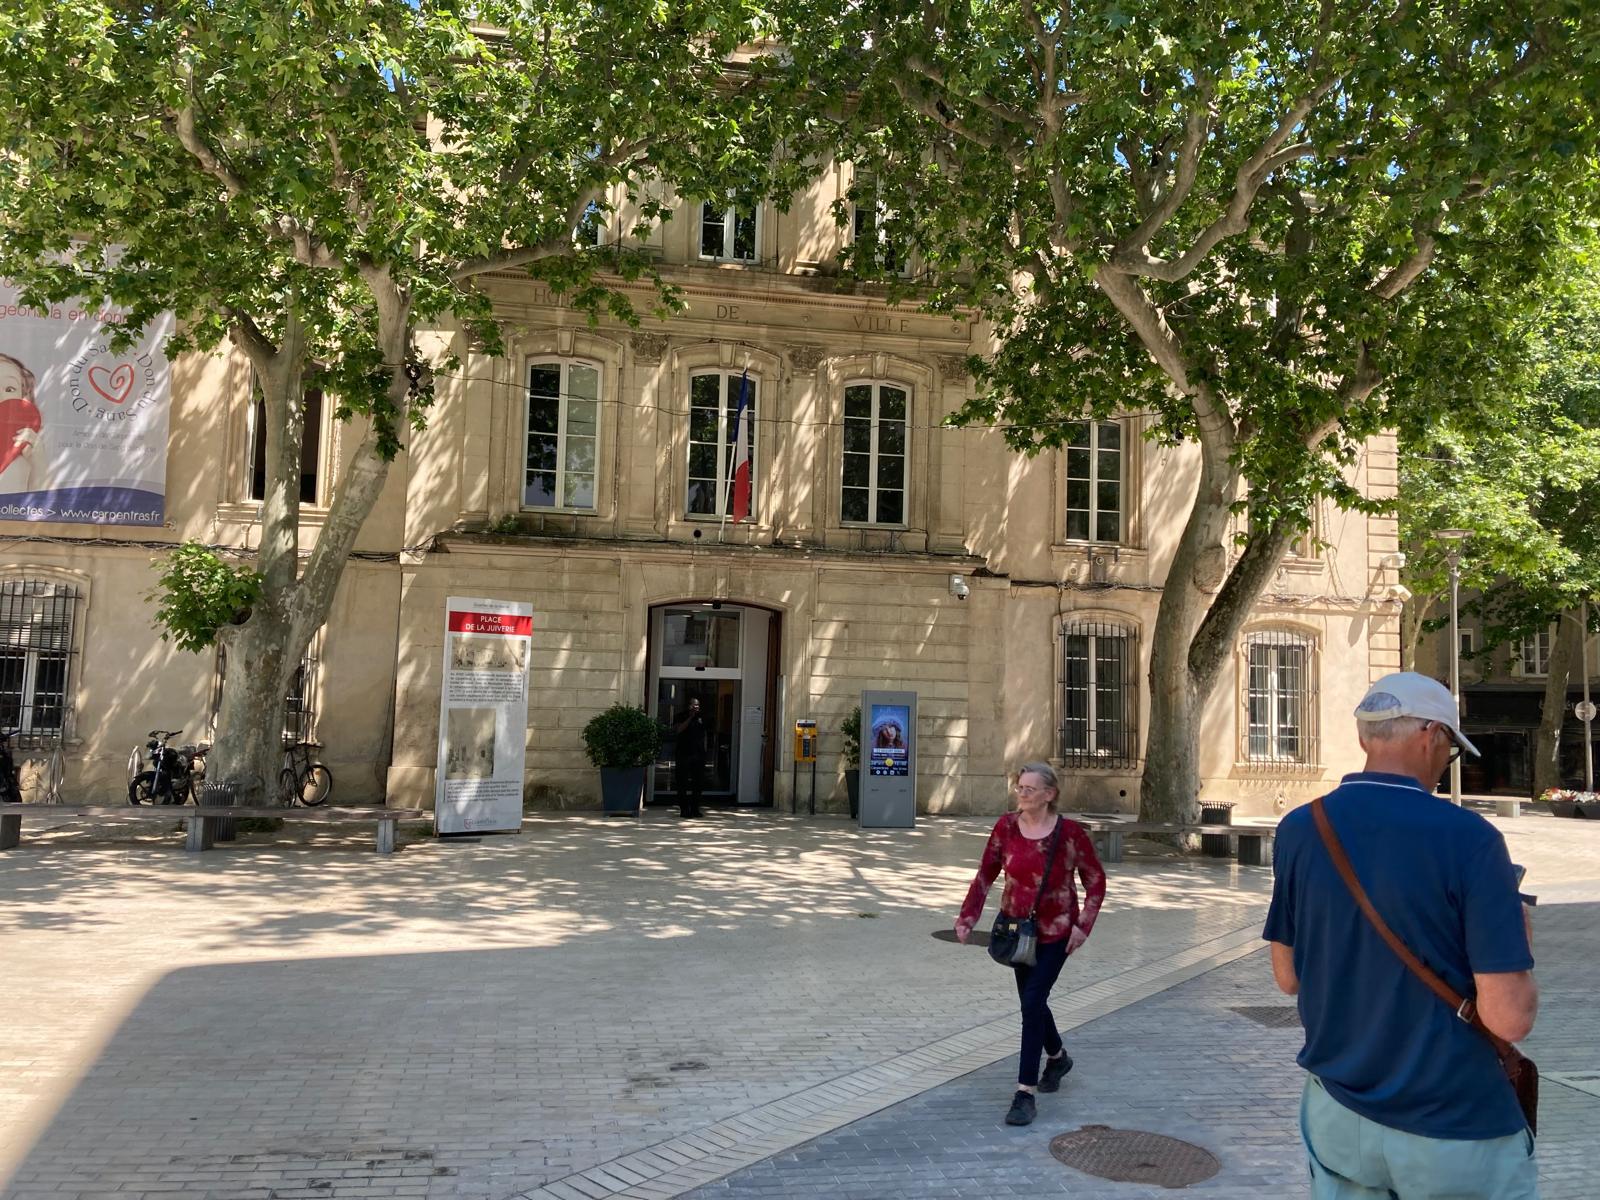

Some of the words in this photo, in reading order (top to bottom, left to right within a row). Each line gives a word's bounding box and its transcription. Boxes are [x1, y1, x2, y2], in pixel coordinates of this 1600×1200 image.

[716, 304, 740, 320] DE
[852, 315, 909, 333] VILLE
[137, 353, 156, 387] Don
[70, 378, 89, 414] Don
[0, 503, 43, 517] ollectes
[465, 623, 475, 631] DE
[487, 624, 515, 633] JUIVERIE
[480, 615, 502, 624] PLACE
